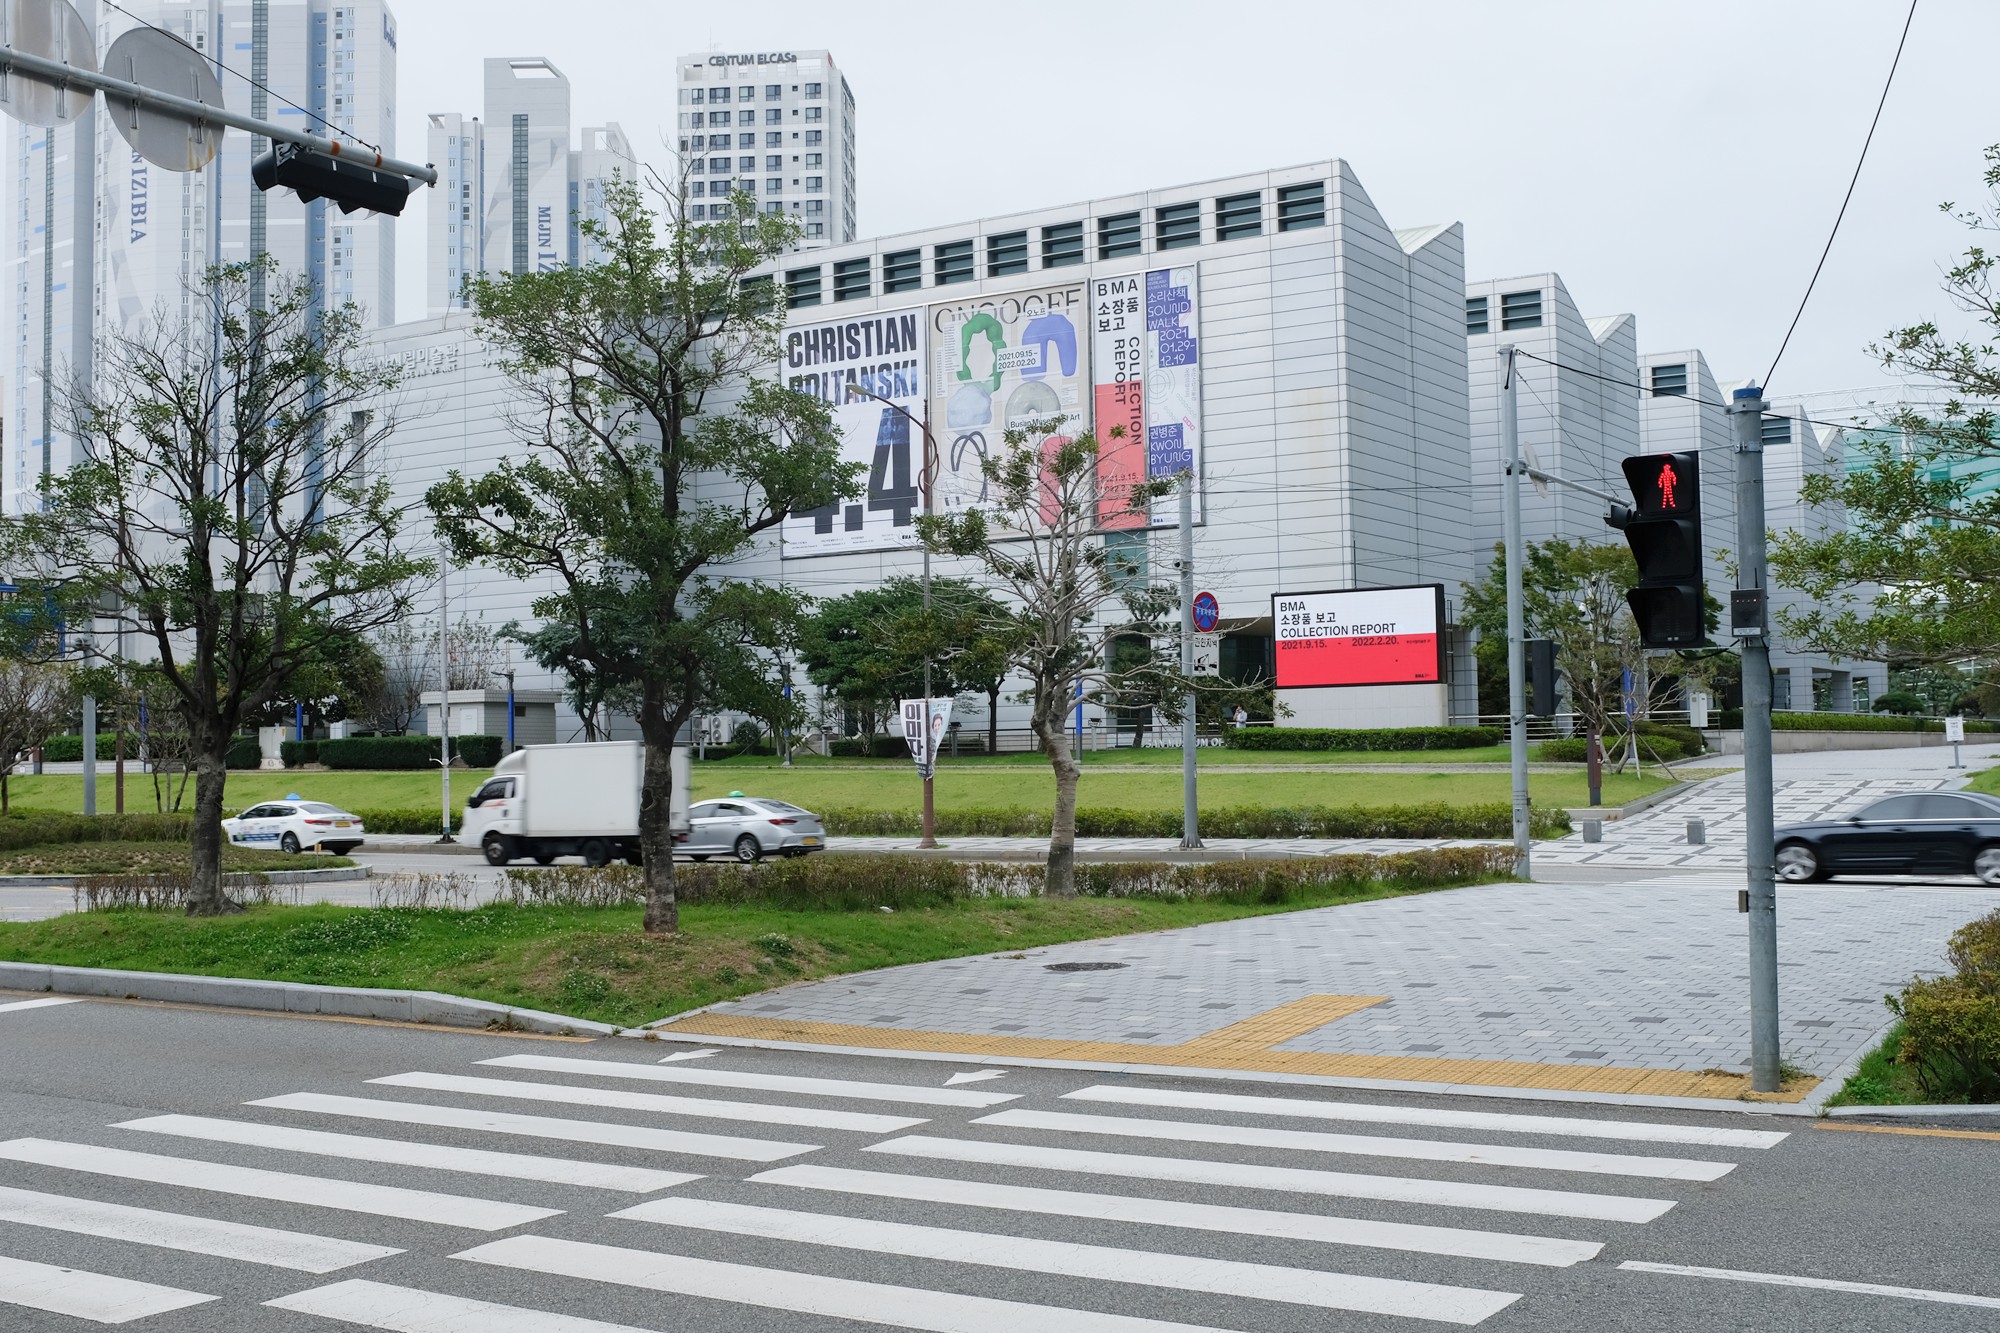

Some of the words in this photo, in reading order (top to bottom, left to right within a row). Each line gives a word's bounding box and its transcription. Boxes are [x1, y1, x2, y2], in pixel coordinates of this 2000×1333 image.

[709, 55, 754, 66] CENTUM
[131, 167, 147, 244] IZIBIA
[538, 206, 551, 248] MIJIN
[1098, 279, 1138, 296] BMA
[1148, 288, 1186, 304] 소리산책
[1098, 297, 1139, 315] 소장품
[1148, 301, 1190, 317] SOUND
[1098, 317, 1125, 332] 보고
[1148, 316, 1178, 330] WALK
[787, 314, 917, 369] CHRISTIAN
[1160, 327, 1187, 341] 2021
[998, 358, 1036, 370] 2022.02.20
[1160, 353, 1185, 367] 12.19
[1115, 339, 1126, 405] REPORT
[1129, 336, 1142, 445] COLLECTION
[1070, 413, 1081, 421] Art
[1150, 425, 1178, 440] 권병준
[1150, 439, 1182, 451] KWON
[1150, 450, 1191, 465] BYUNG
[1280, 601, 1306, 612] BMA
[1281, 613, 1311, 625] 소장품
[1316, 612, 1336, 623] 보고
[1281, 625, 1348, 638] COLLECTION
[1352, 623, 1396, 635] REPORT
[1281, 639, 1327, 650] 2021.9.15.
[1352, 636, 1399, 647] 2022.2.20.
